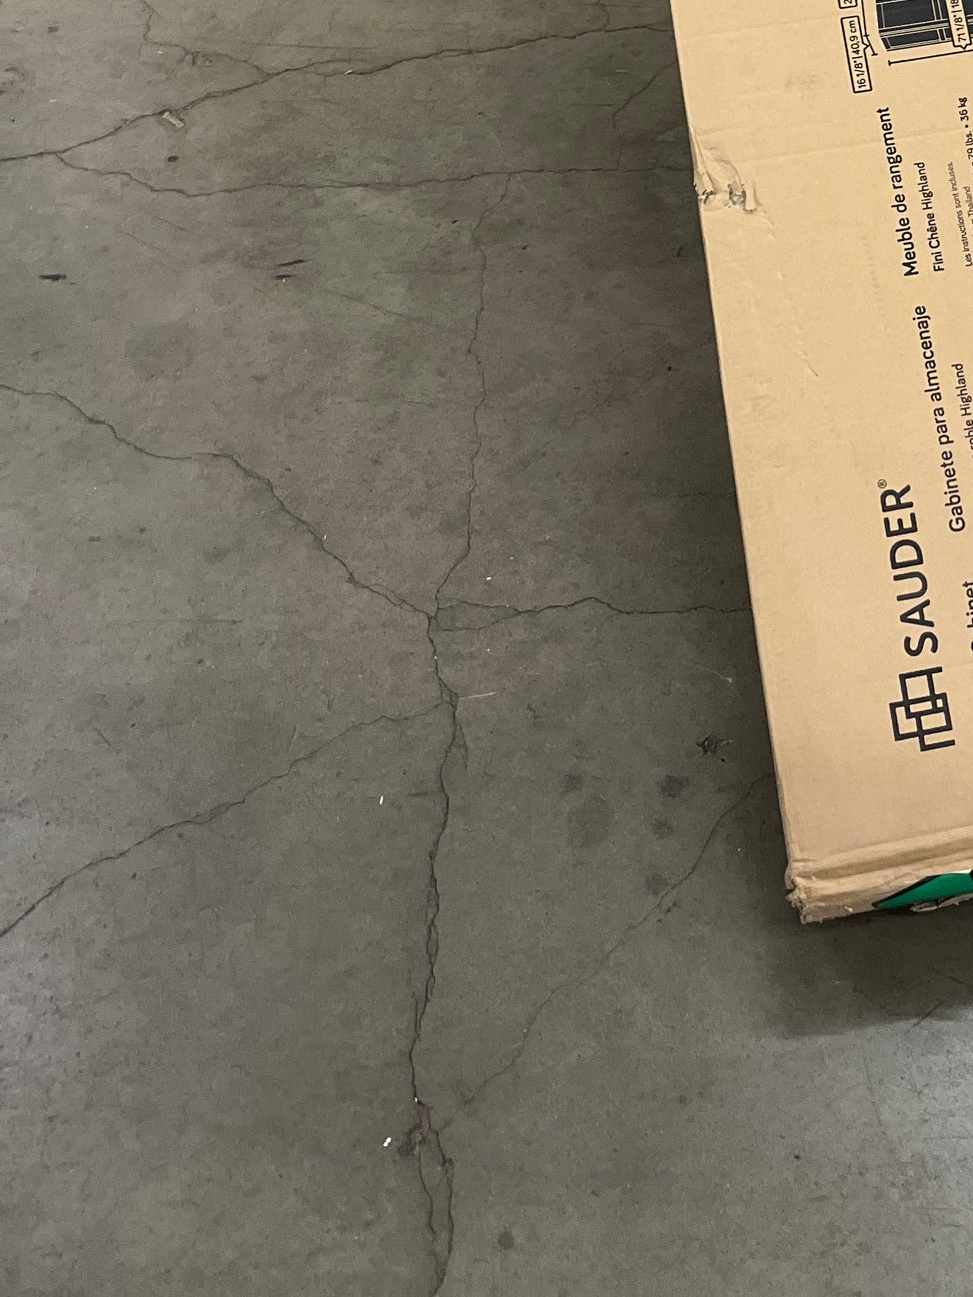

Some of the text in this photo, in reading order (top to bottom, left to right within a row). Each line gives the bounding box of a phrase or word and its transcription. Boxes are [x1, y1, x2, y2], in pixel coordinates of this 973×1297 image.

[848, 20, 857, 34] cm
[957, 33, 967, 42] 71
[857, 78, 866, 89] 16
[958, 96, 968, 108] kg
[959, 109, 969, 122] 36
[964, 131, 973, 147] lbs.
[876, 107, 919, 277] Meuble de rangement
[952, 190, 961, 209] sont
[913, 162, 945, 272] Fini Chêne Highland
[965, 253, 973, 267] Les
[951, 363, 973, 417] Highland
[912, 304, 966, 532] Gabinete para almacenaje
